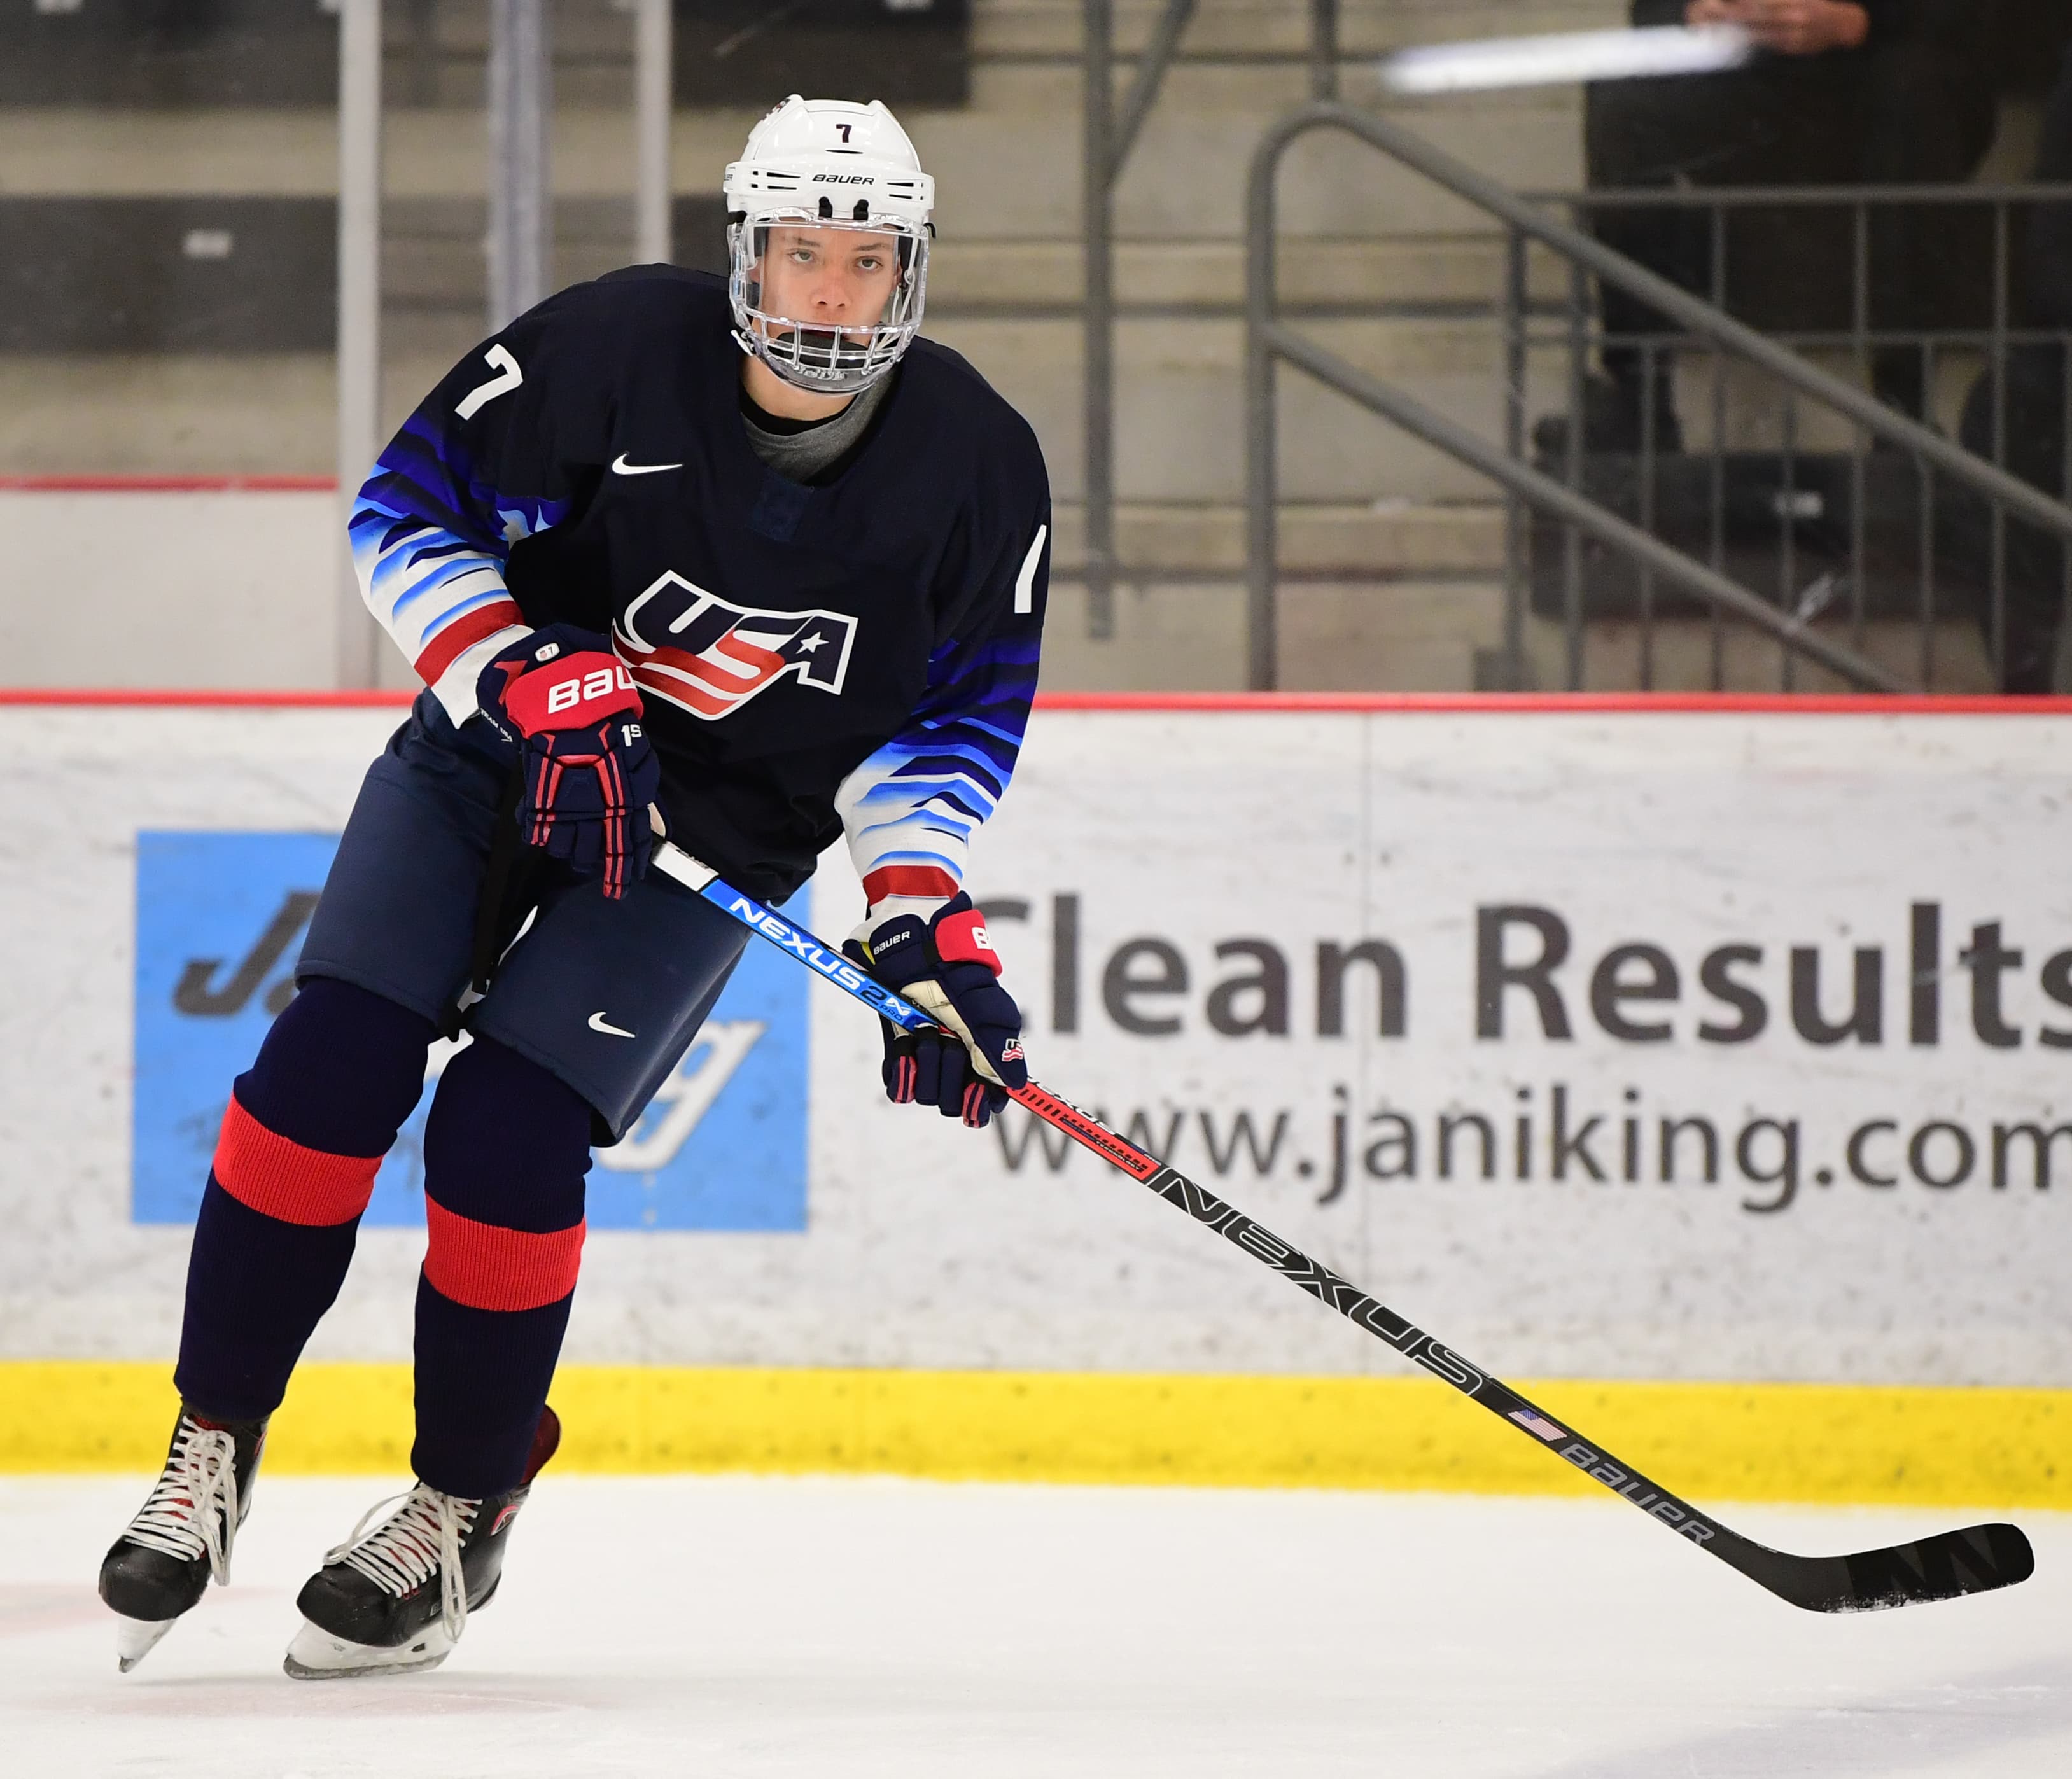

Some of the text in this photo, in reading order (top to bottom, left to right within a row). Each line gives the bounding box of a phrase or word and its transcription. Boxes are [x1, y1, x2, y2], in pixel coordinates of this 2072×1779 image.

[836, 123, 852, 143] 7
[454, 343, 524, 421] 7
[611, 569, 858, 720] USA
[729, 897, 865, 991] NEXUS
[879, 1005, 904, 1021] PRO
[995, 1085, 2072, 1212] www.janiking.com
[1146, 1167, 1483, 1395] NEXUS
